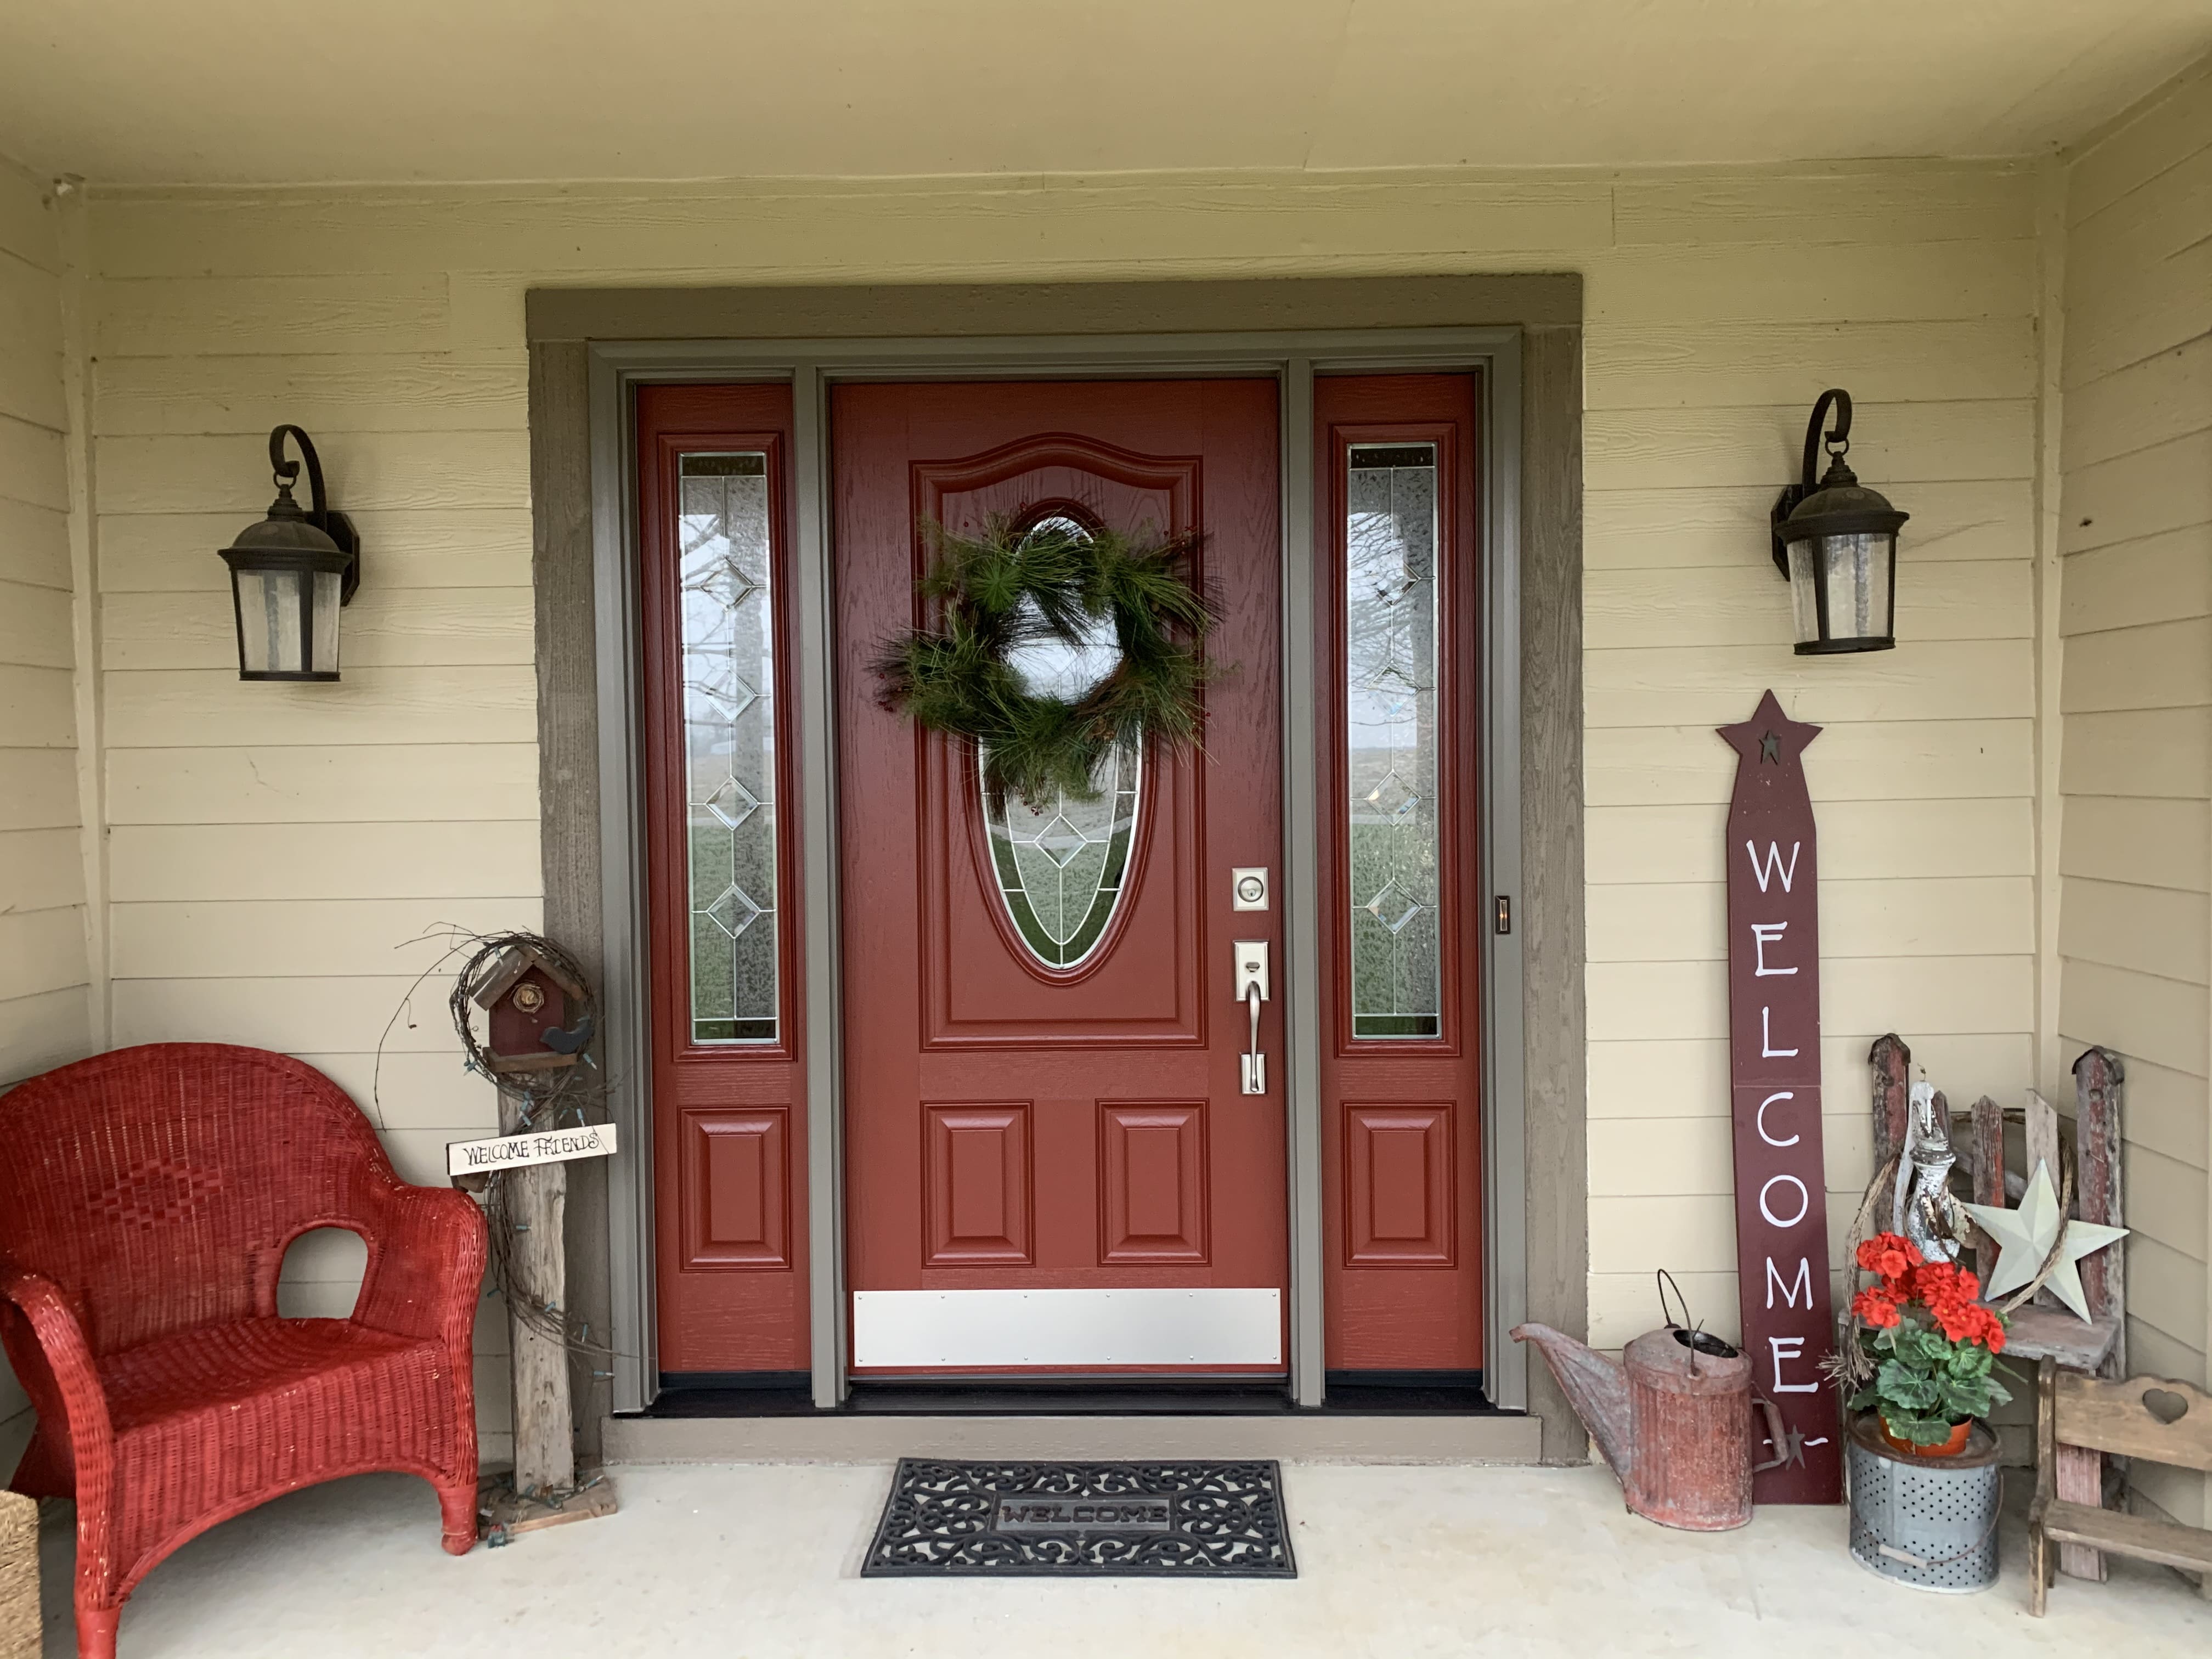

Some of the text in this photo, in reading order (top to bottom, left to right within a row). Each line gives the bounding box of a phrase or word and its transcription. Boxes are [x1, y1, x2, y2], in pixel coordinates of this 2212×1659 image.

[1746, 839, 1819, 1393] WELCOME
[462, 1133, 599, 1165] WELCOME FRIENDS
[1001, 1505, 1167, 1523] WELCOME
